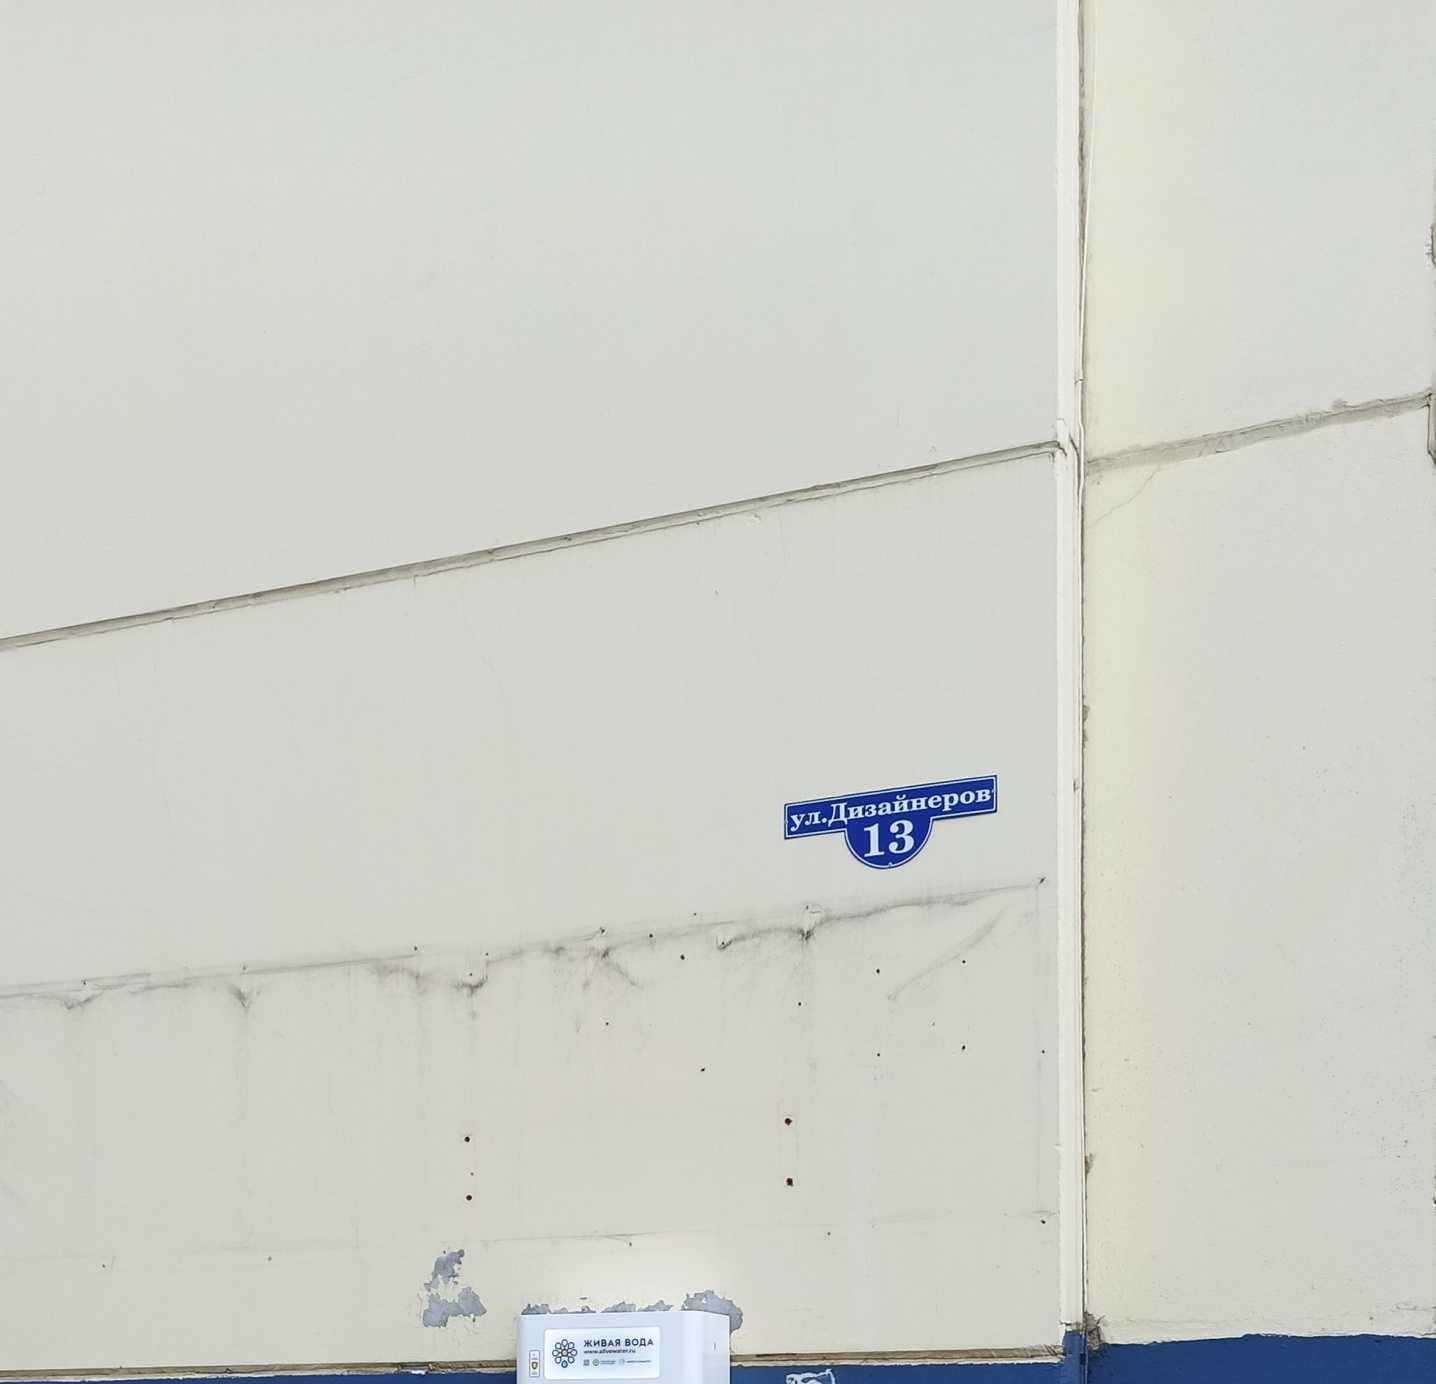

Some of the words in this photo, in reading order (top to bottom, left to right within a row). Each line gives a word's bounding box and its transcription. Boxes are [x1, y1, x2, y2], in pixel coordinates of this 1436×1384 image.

[790, 789, 991, 832] ул.Дизайнеров
[863, 819, 915, 858] 13
[583, 1338, 621, 1347] ЖИВАЯ
[624, 1338, 654, 1347] ВОДА
